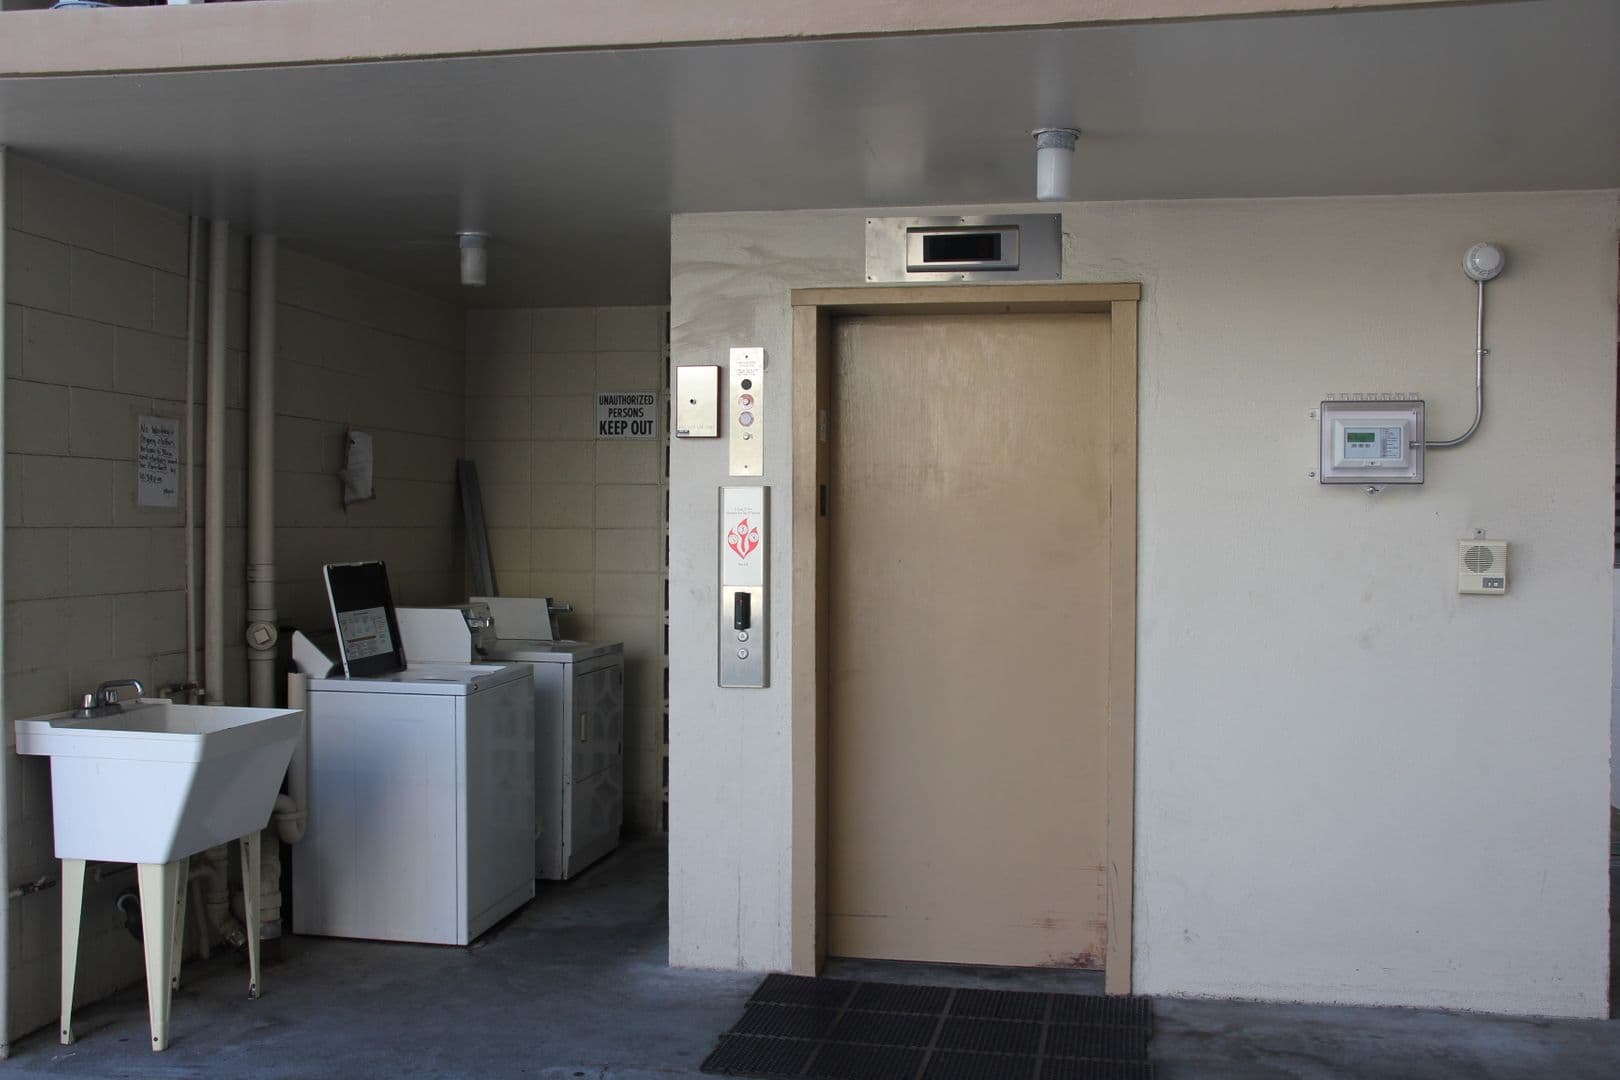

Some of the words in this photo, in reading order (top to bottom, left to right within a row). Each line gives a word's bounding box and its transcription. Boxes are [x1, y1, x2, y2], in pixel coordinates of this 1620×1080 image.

[599, 394, 654, 406] UNAUTHORIZED
[608, 407, 644, 418] PERSONS
[599, 420, 628, 436] KEEP
[631, 420, 654, 435] OUT
